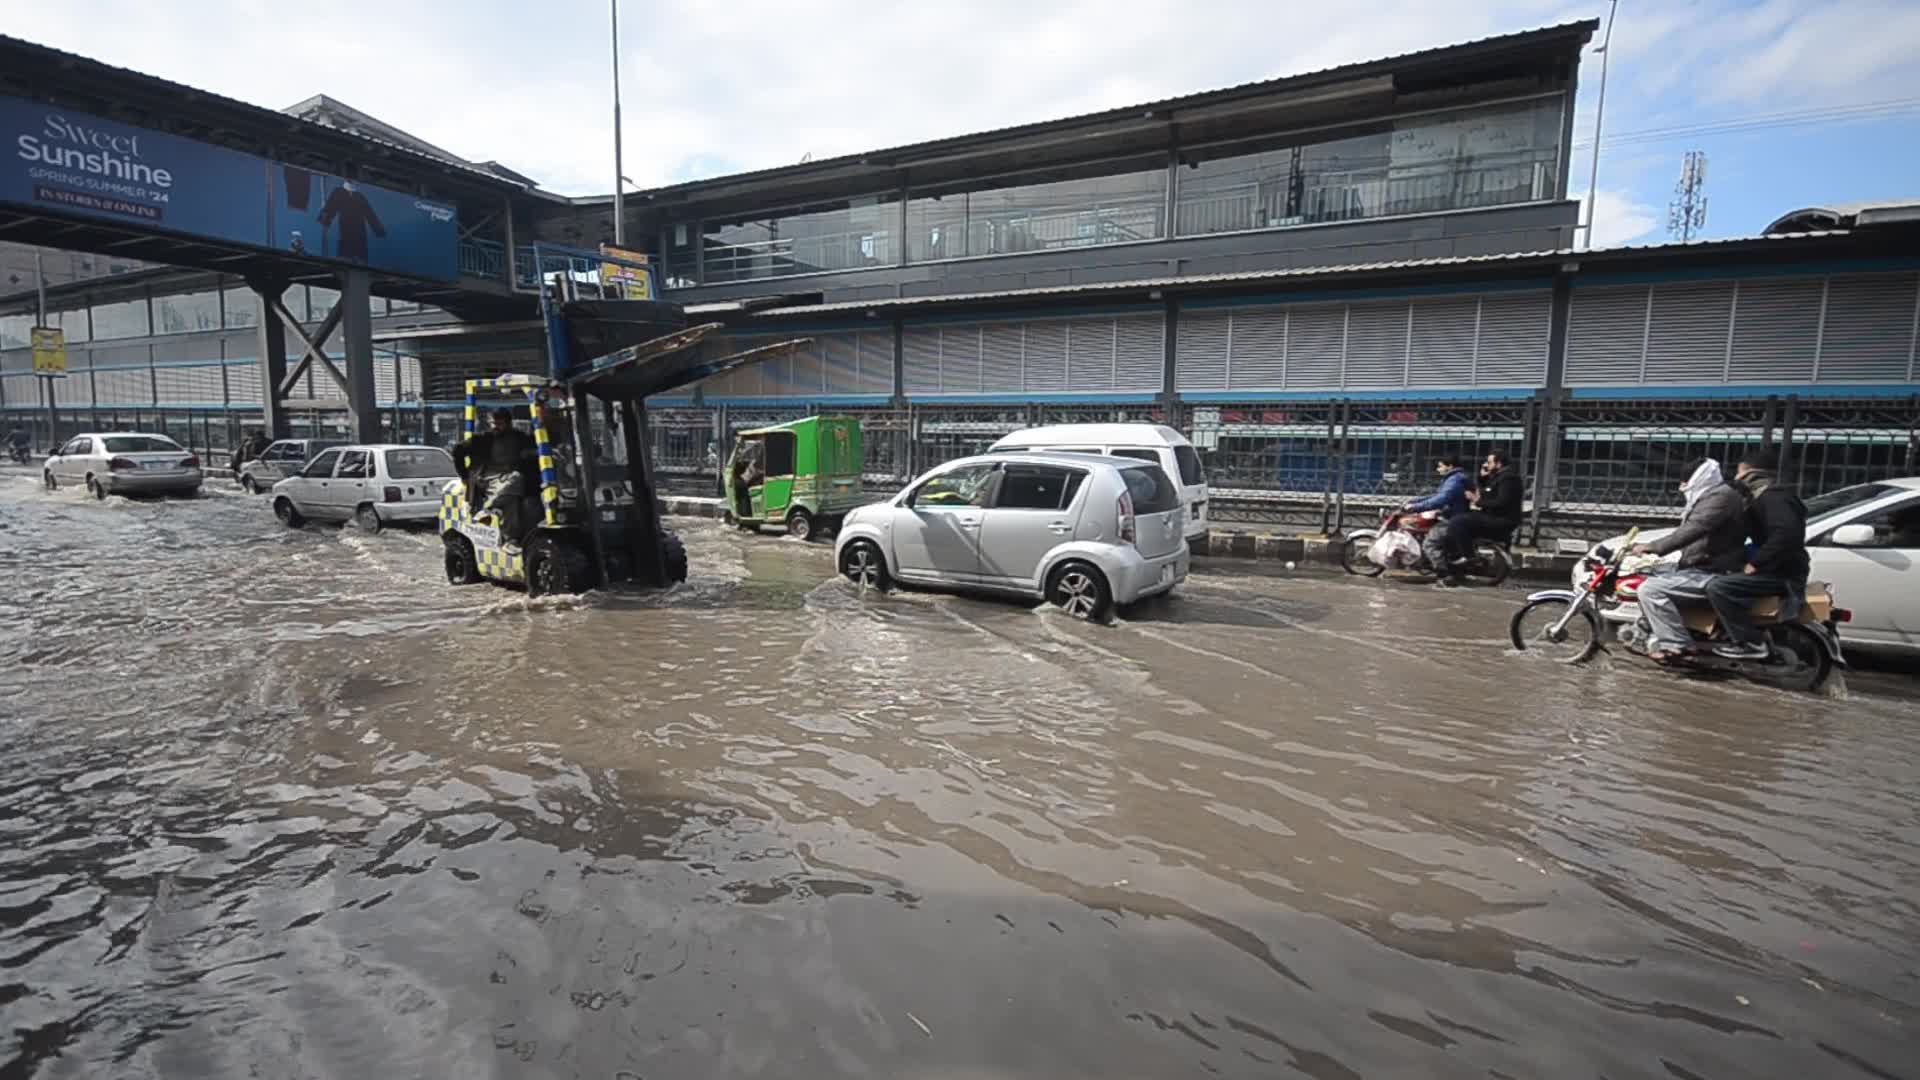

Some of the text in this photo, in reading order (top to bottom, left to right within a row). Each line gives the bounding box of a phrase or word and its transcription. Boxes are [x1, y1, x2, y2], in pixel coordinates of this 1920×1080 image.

[44, 114, 142, 158] Sweet
[18, 135, 172, 187] Sunshine
[29, 168, 84, 187] SPRING
[86, 178, 146, 198] SUMMER
